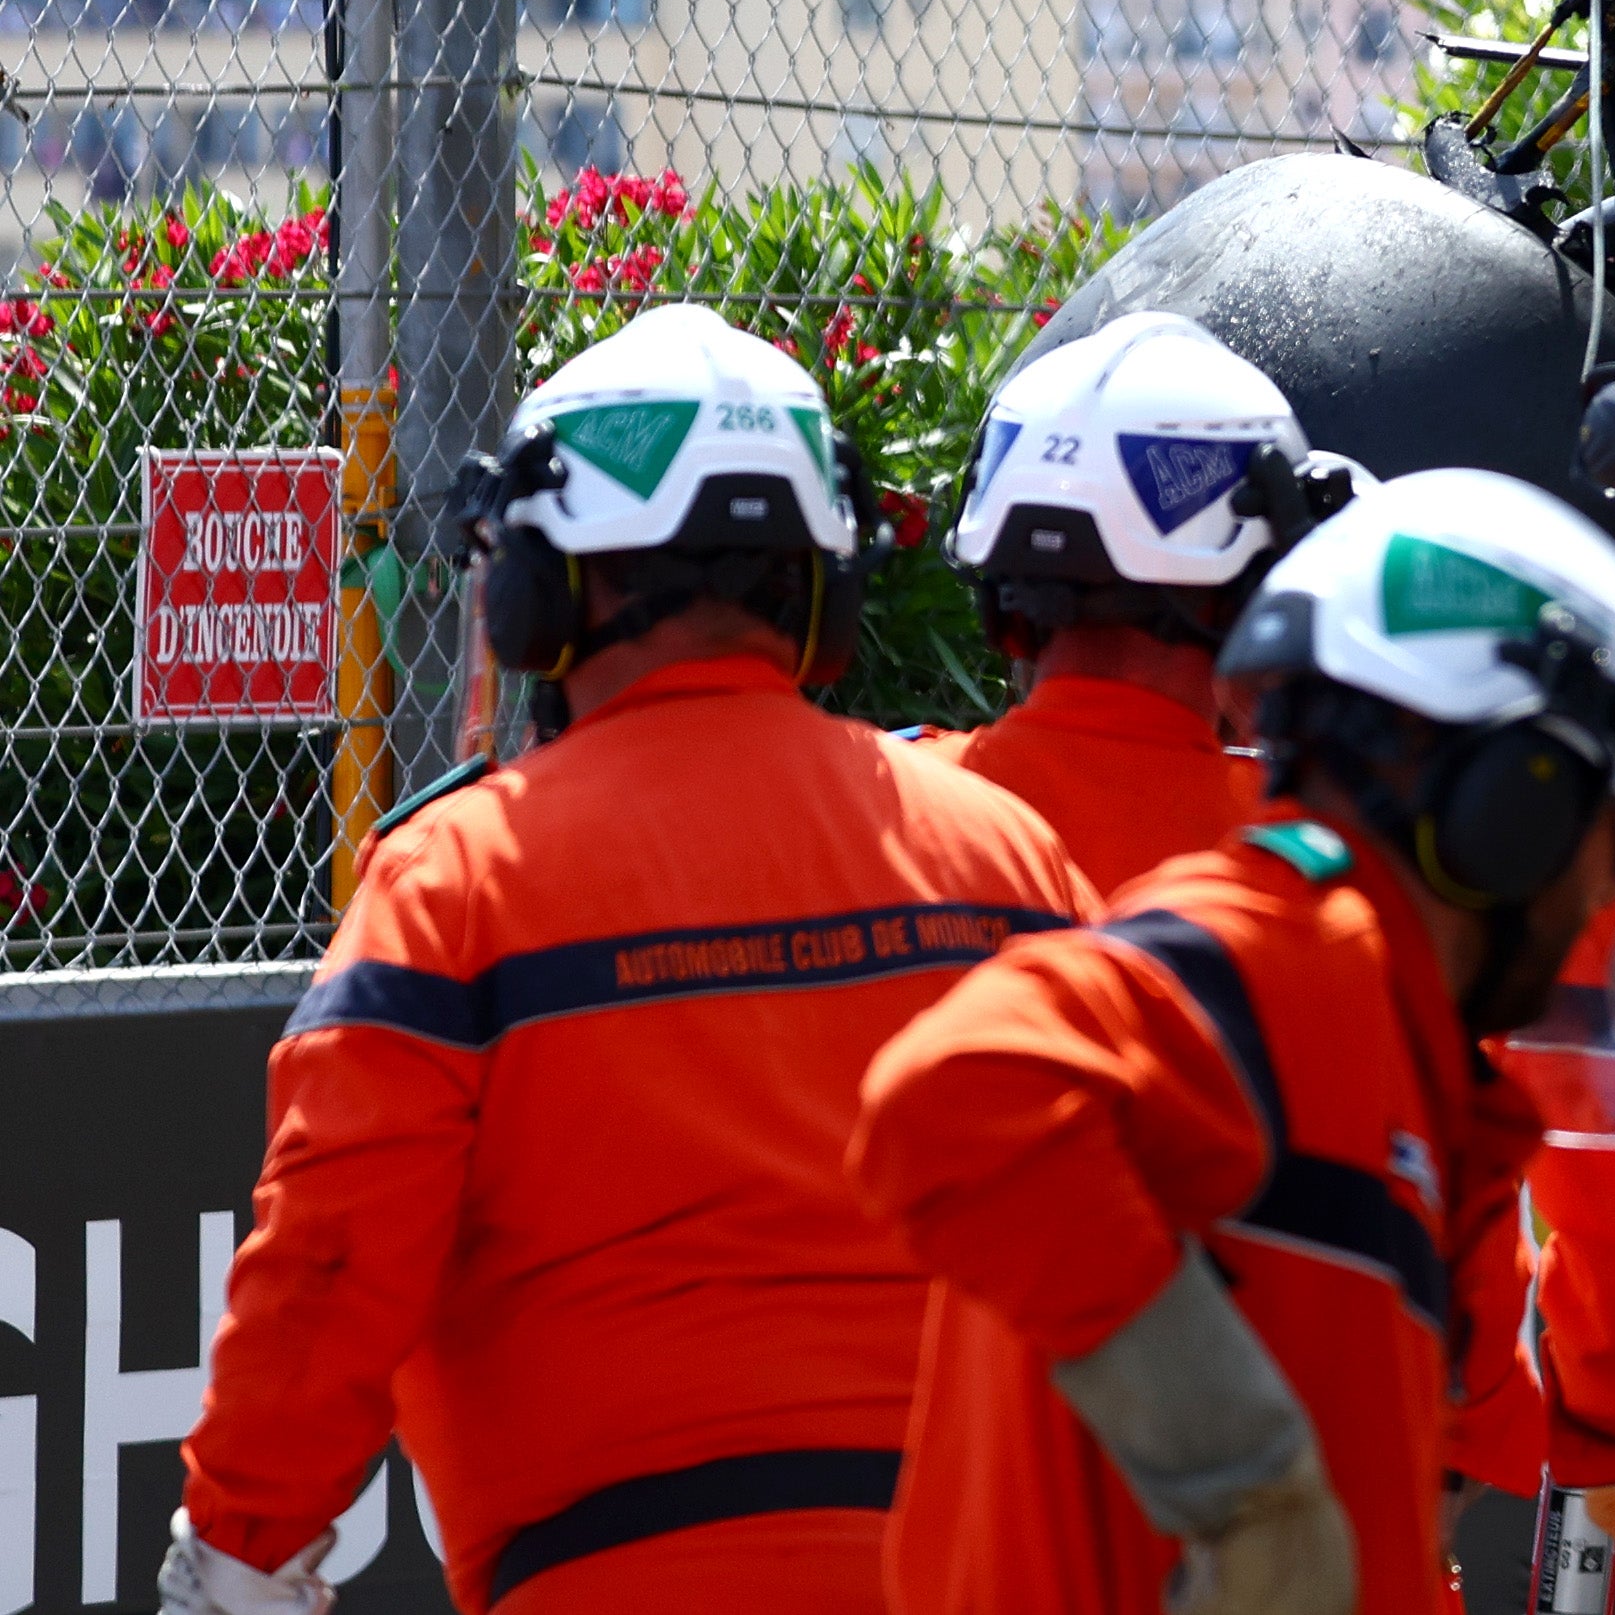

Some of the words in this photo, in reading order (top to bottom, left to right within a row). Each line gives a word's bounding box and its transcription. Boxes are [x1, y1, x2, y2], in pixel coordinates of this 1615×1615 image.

[1041, 434, 1079, 465] 22
[1146, 444, 1234, 511] ACM
[183, 510, 303, 572] BOUCHE
[157, 602, 322, 664] D'INCENDIE
[615, 932, 788, 990] AUTOMOBILE
[790, 923, 868, 973] CLUB
[871, 915, 912, 960] DE
